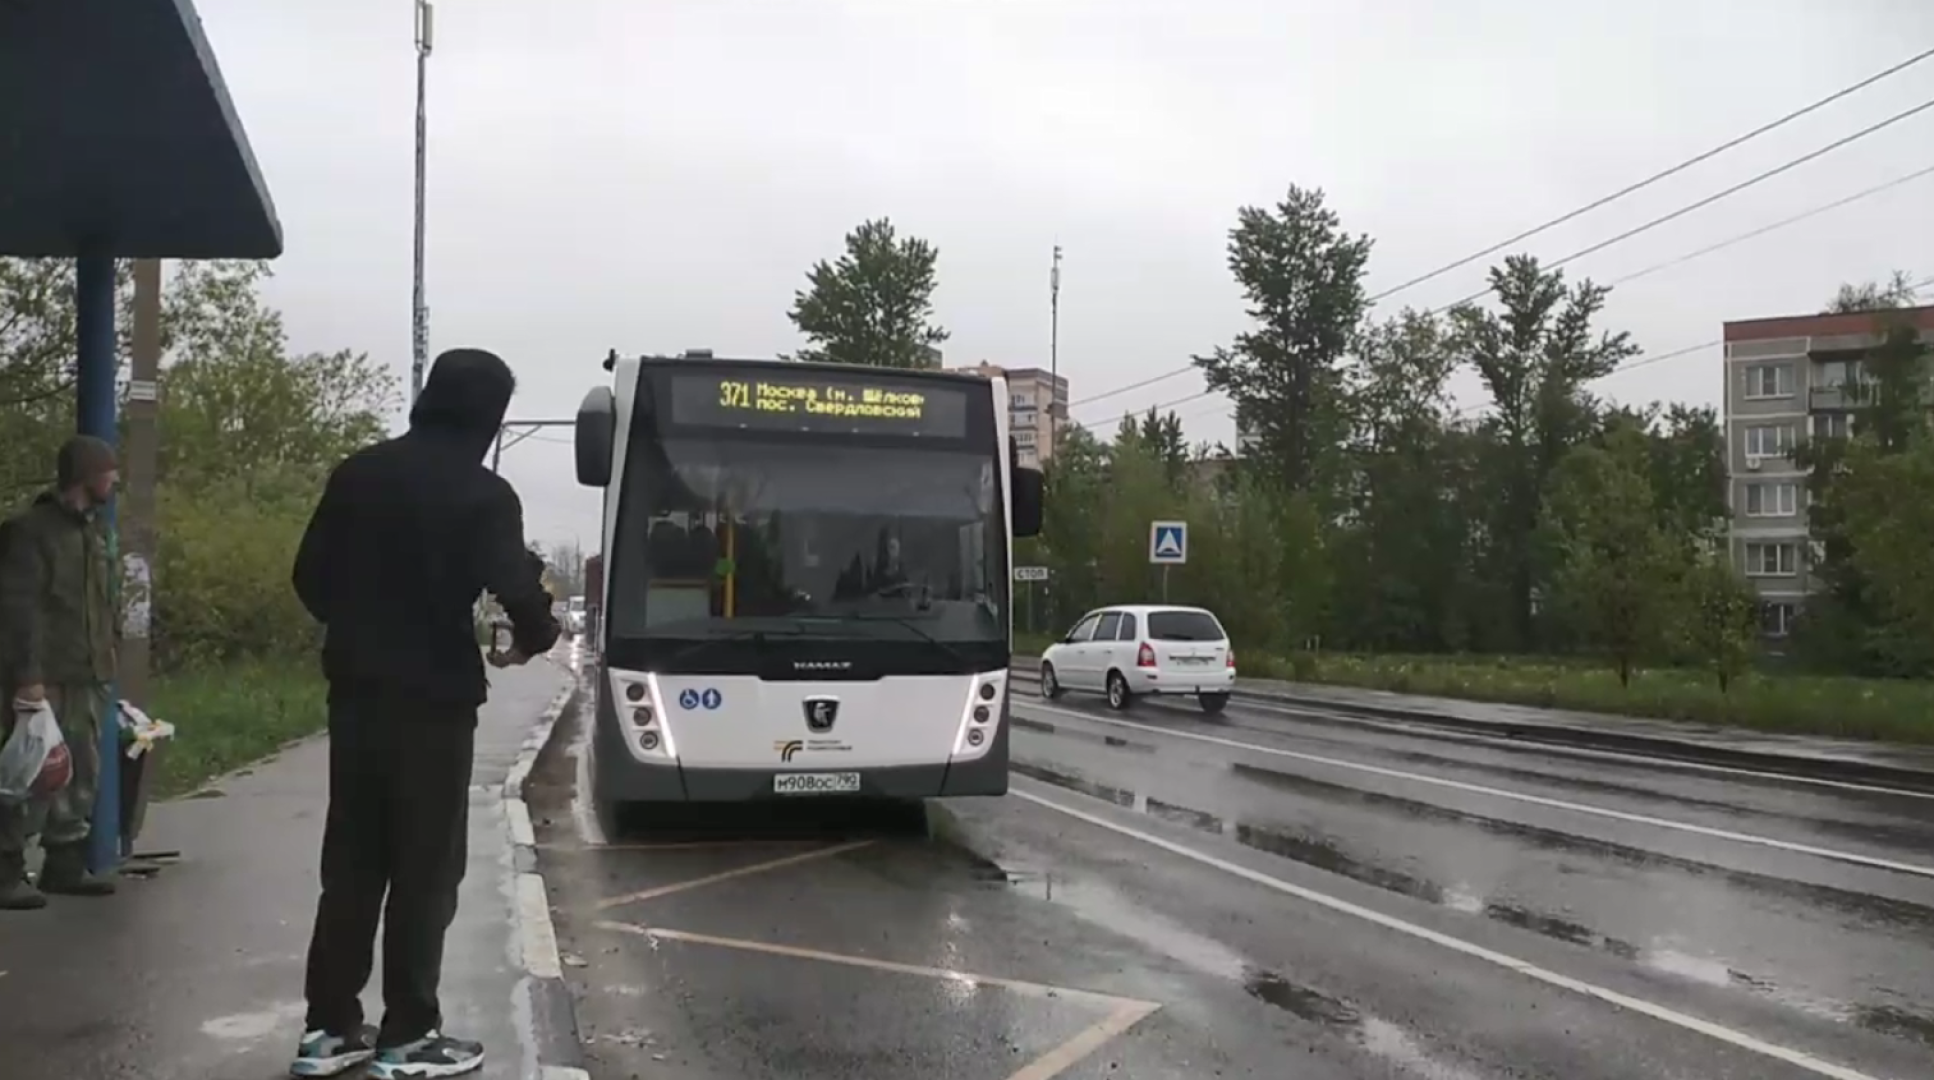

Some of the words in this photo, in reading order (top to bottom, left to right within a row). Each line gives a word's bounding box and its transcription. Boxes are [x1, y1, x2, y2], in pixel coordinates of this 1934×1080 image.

[720, 381, 749, 407] 371
[756, 382, 817, 399] Москва
[863, 388, 925, 405] Щёлков
[756, 399, 796, 412] пос.
[805, 399, 921, 418] Свердловский
[1017, 569, 1045, 579] СТОП
